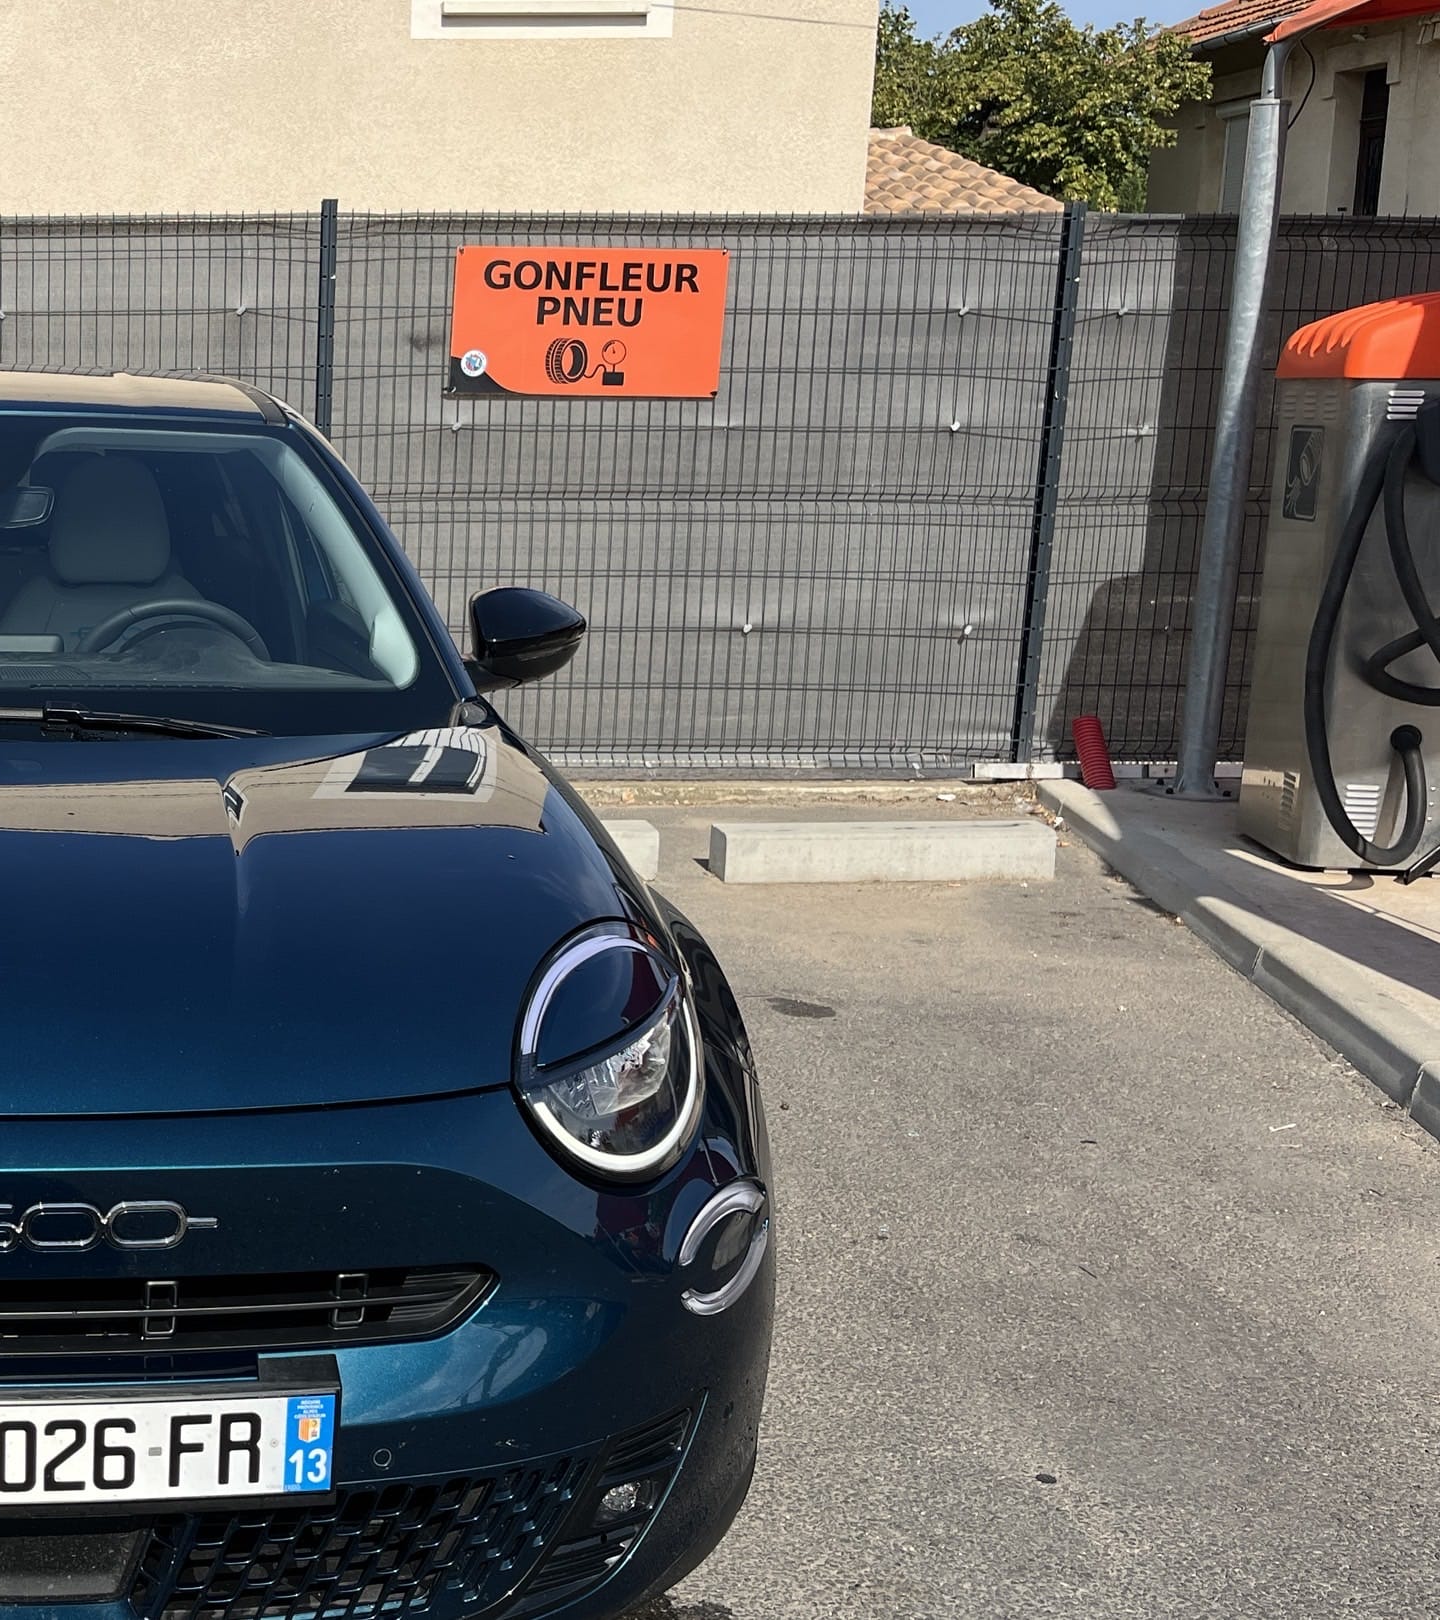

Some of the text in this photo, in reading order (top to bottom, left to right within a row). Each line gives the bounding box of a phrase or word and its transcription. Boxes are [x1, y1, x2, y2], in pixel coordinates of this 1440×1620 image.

[483, 260, 699, 293] GONFLEUR
[536, 296, 643, 327] PNEU
[168, 1412, 261, 1488] FR
[288, 1448, 328, 1484] 13
